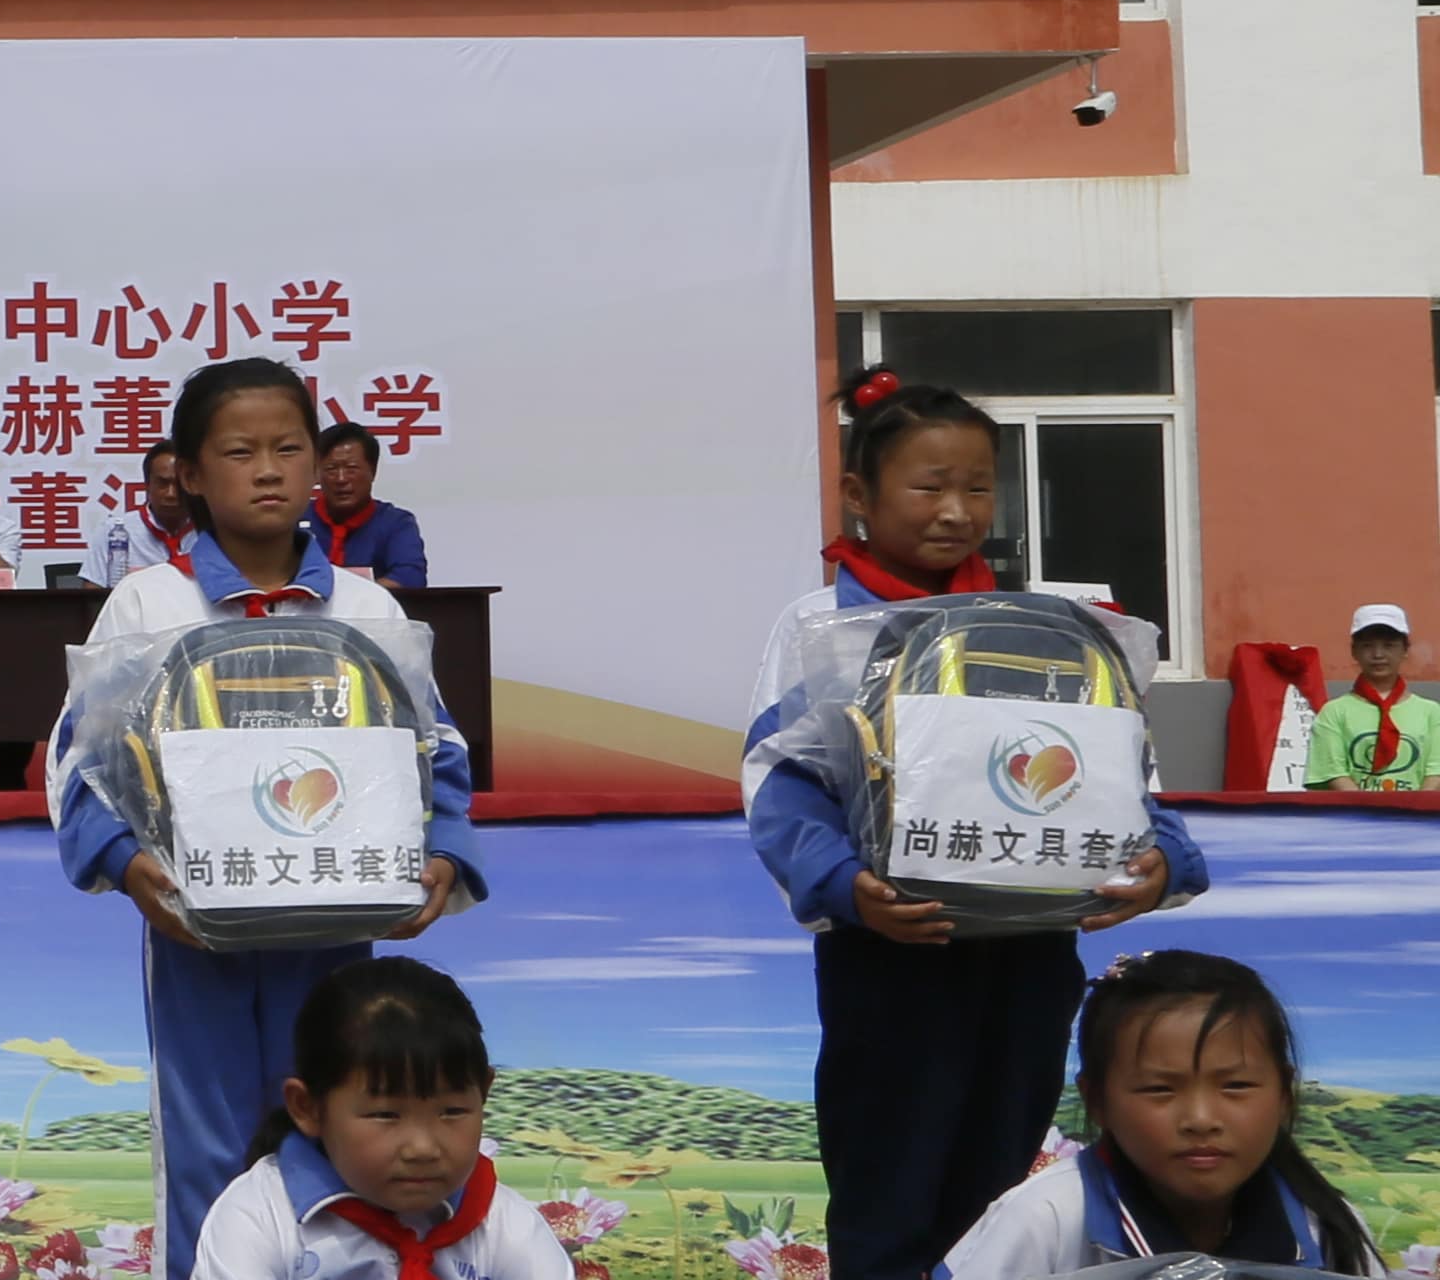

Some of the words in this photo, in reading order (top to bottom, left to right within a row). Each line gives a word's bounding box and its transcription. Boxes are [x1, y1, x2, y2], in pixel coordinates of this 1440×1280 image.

[182, 844, 425, 888] 尚赫文具套组
